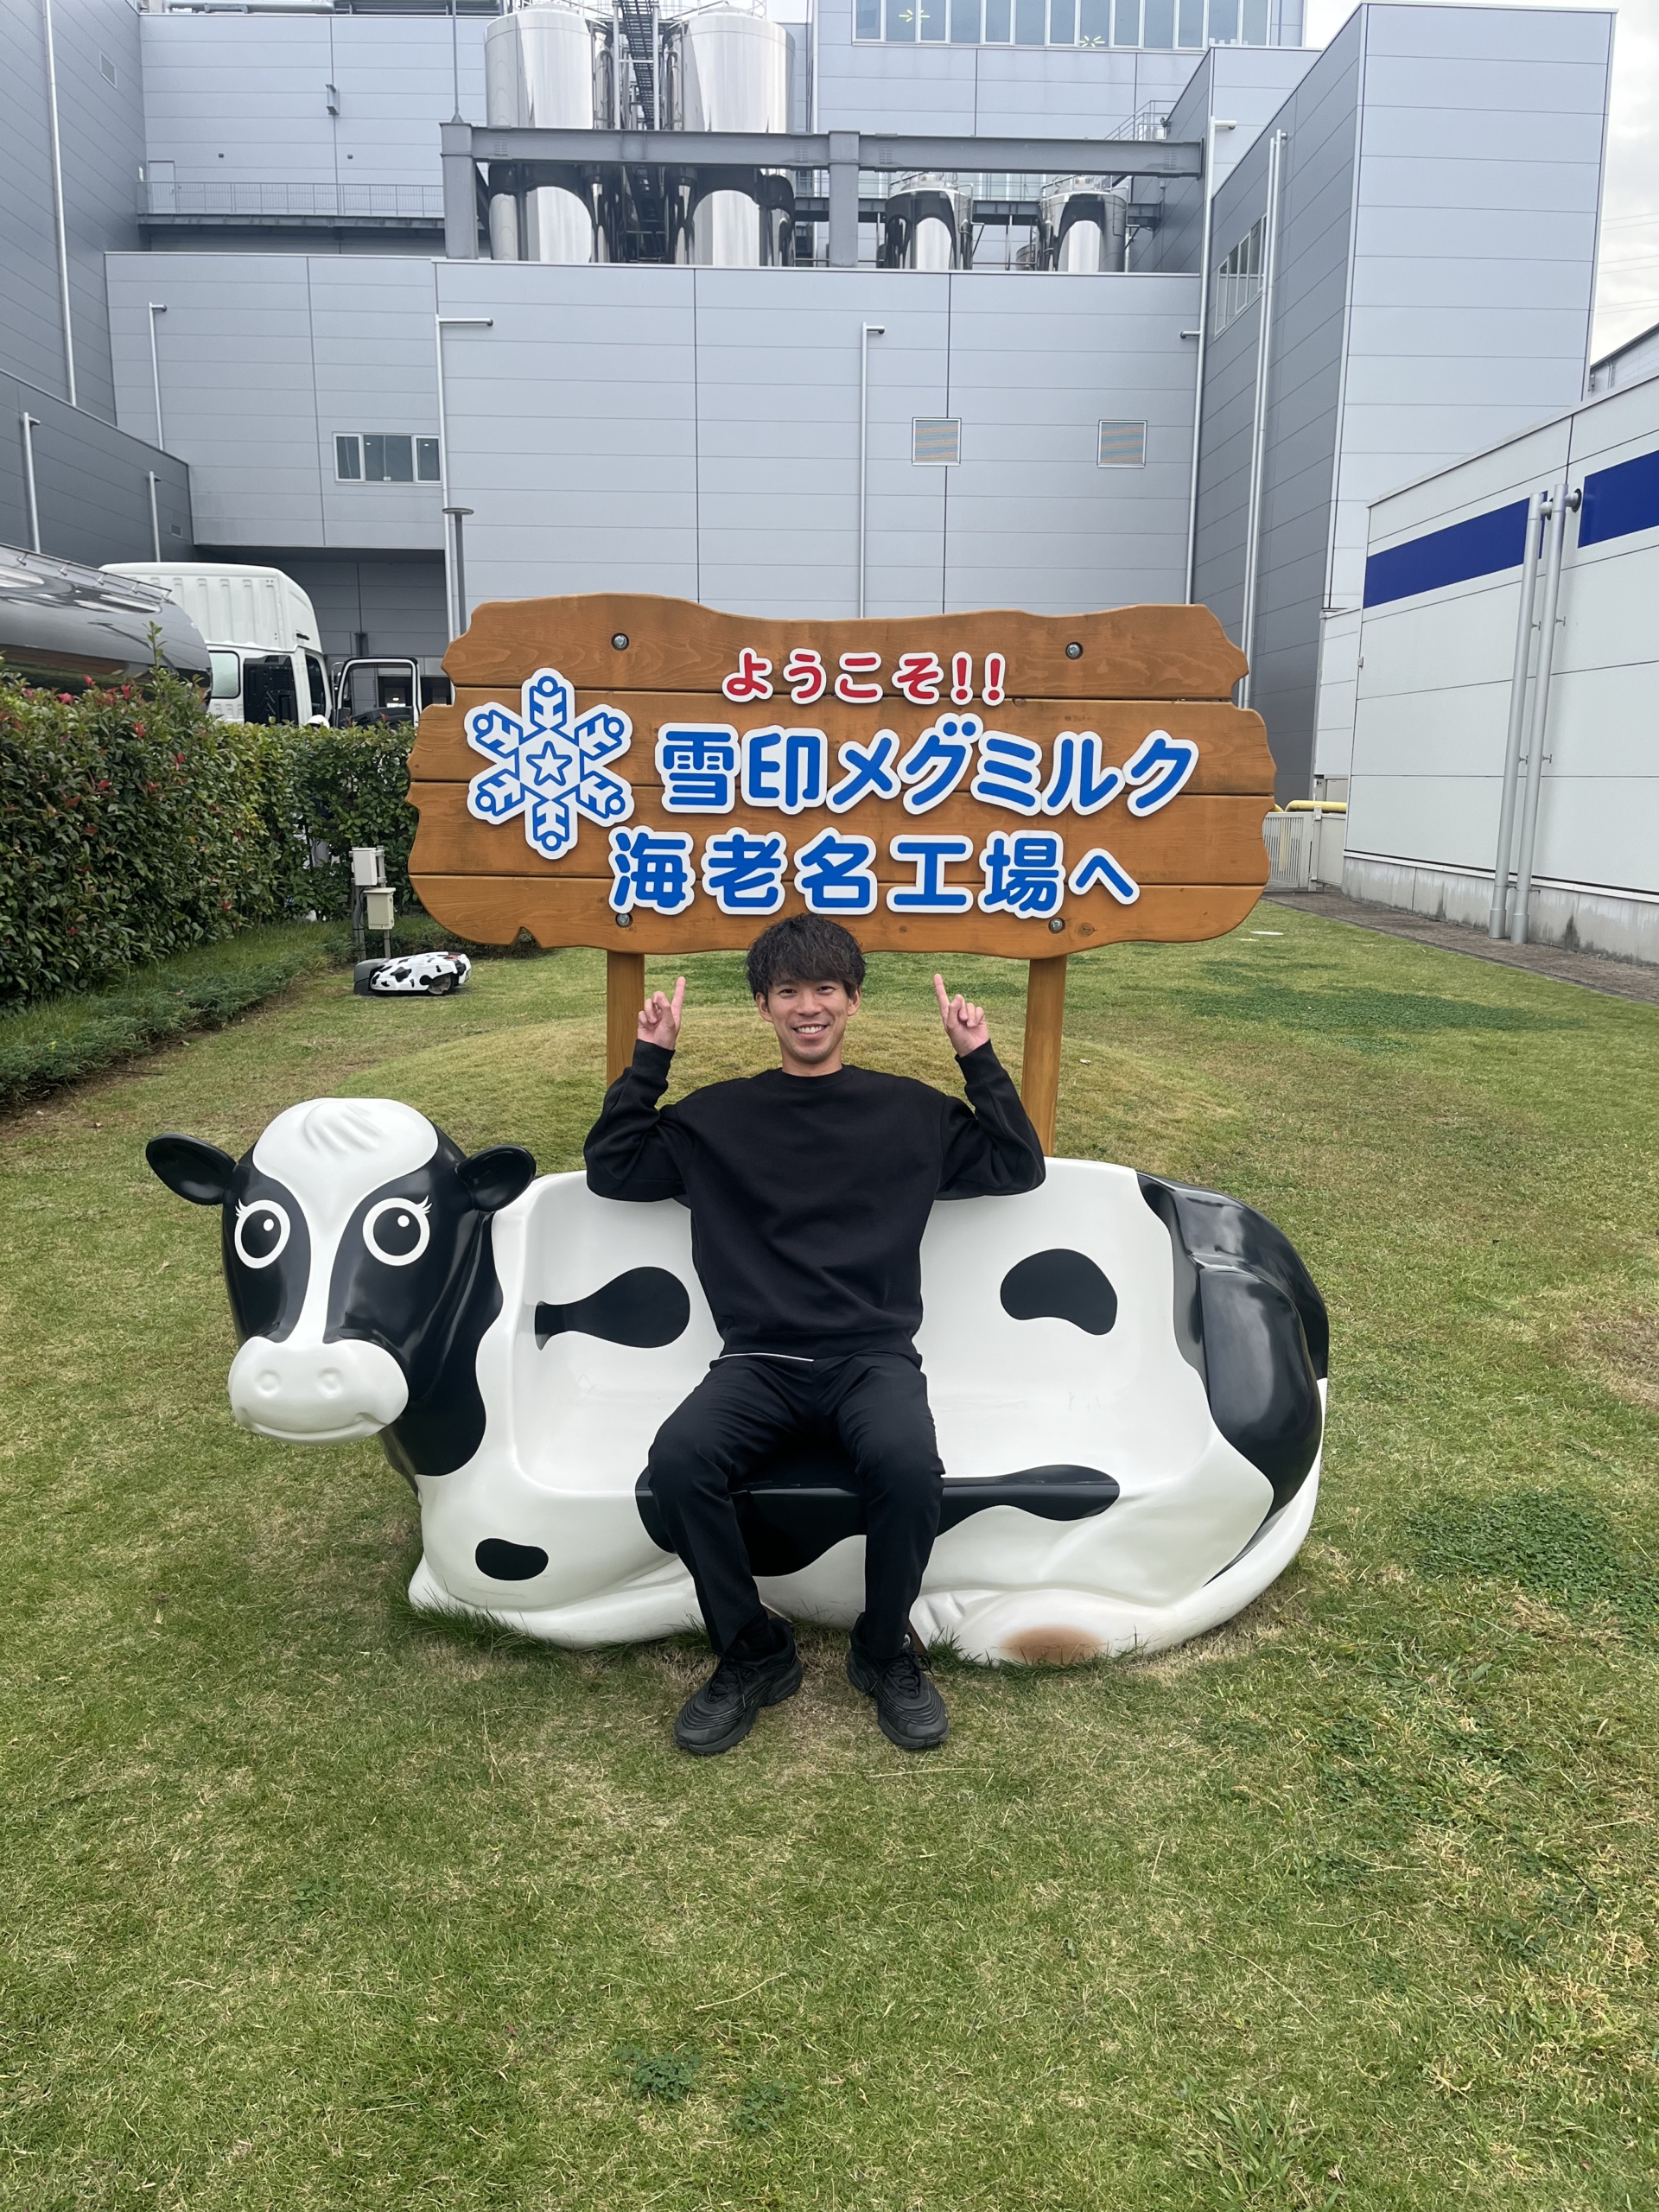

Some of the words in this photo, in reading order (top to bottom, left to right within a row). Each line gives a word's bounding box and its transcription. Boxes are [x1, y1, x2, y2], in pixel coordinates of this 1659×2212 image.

[726, 652, 1002, 702] ようこそ!!
[662, 721, 1192, 810] 雪印メグミルク
[613, 831, 1135, 912] 海老名工場へ
